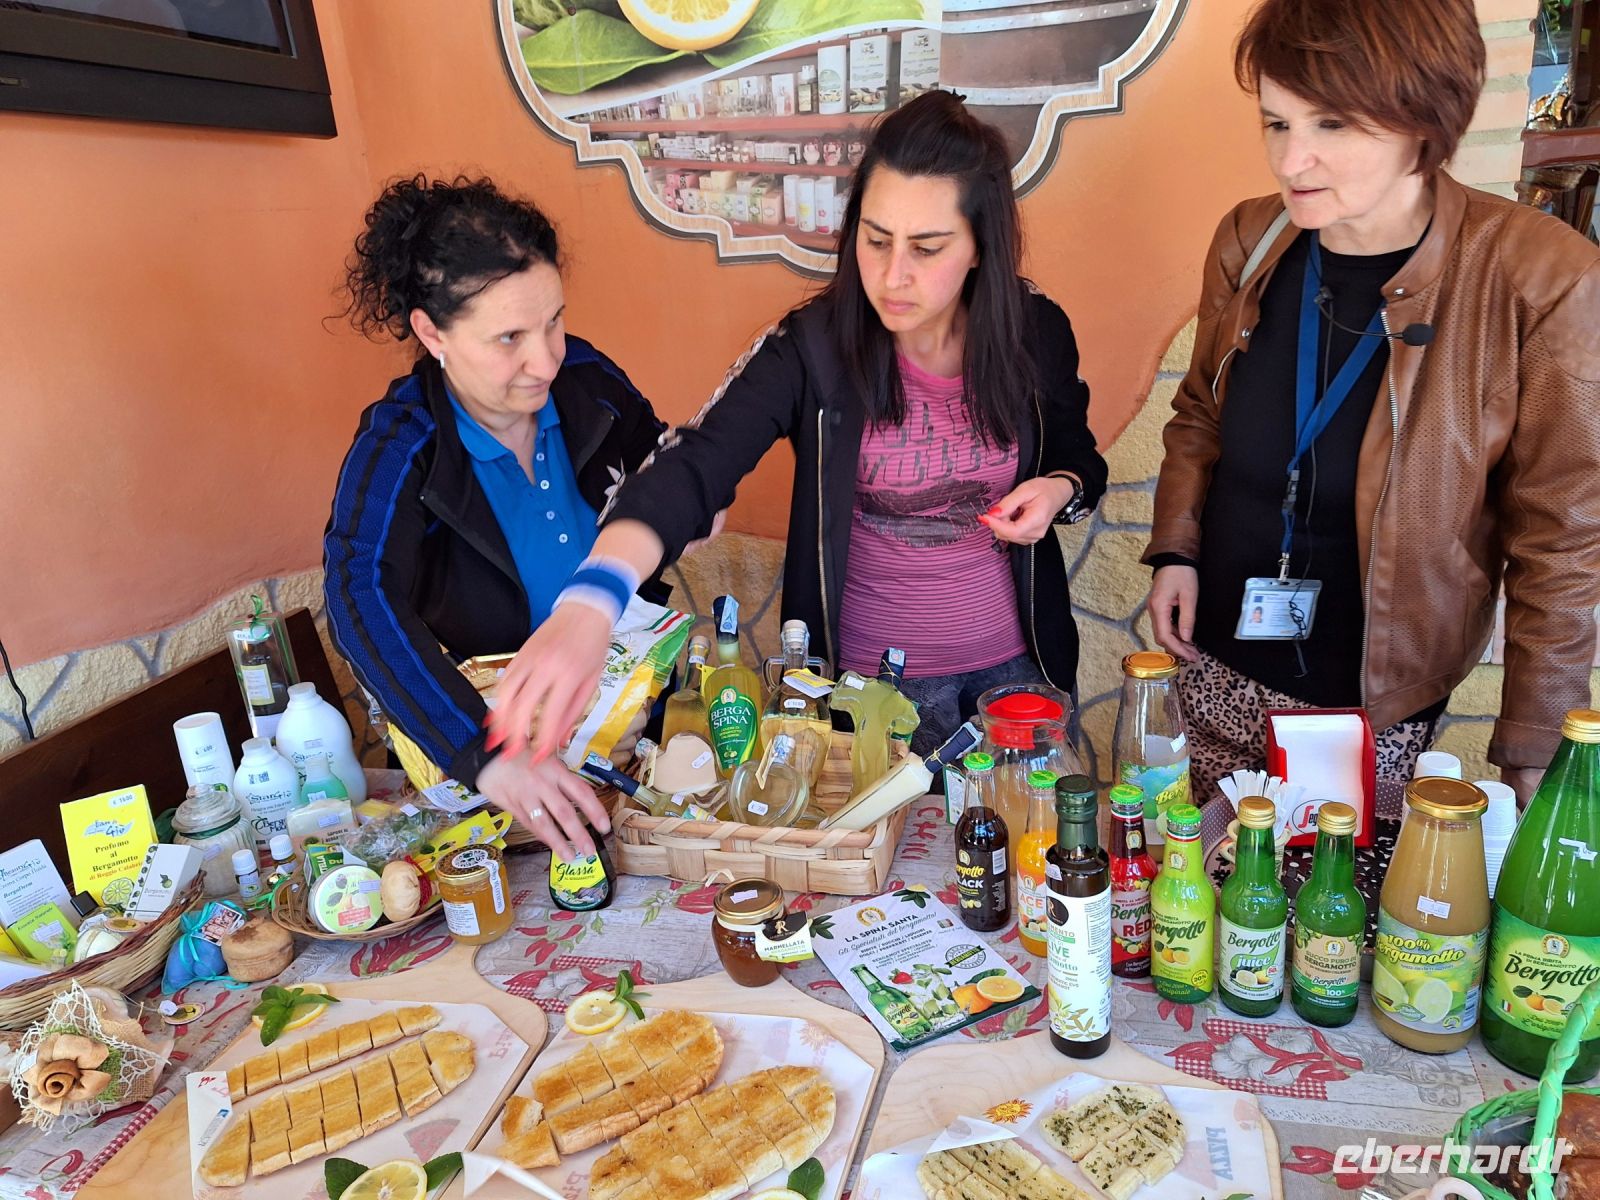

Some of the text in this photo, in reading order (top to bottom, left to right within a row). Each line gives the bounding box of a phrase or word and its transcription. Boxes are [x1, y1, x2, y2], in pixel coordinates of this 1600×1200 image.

[711, 706, 751, 722] BERGA
[713, 716, 749, 730] SPINA
[95, 840, 130, 853] Profumo
[110, 850, 118, 858] al
[92, 854, 138, 872] Bergamotto
[554, 863, 594, 882] Glassa
[957, 876, 984, 889] LACK
[1019, 894, 1044, 908] ACE
[844, 914, 919, 943] LA SPINA SANTA
[1122, 918, 1152, 937] RED
[764, 940, 805, 952] MARMELLATA
[1228, 930, 1281, 954] Bergotto
[1387, 934, 1432, 951] 100%
[1236, 955, 1271, 968] juice
[1304, 955, 1358, 970] BERGAMOTTO
[1306, 950, 1330, 962] SUCCO
[1522, 953, 1541, 962] PRIMA
[1532, 960, 1577, 969] BERGAMOTTO
[1504, 953, 1600, 991] Bergotto
[1312, 976, 1348, 988] Bergotto
